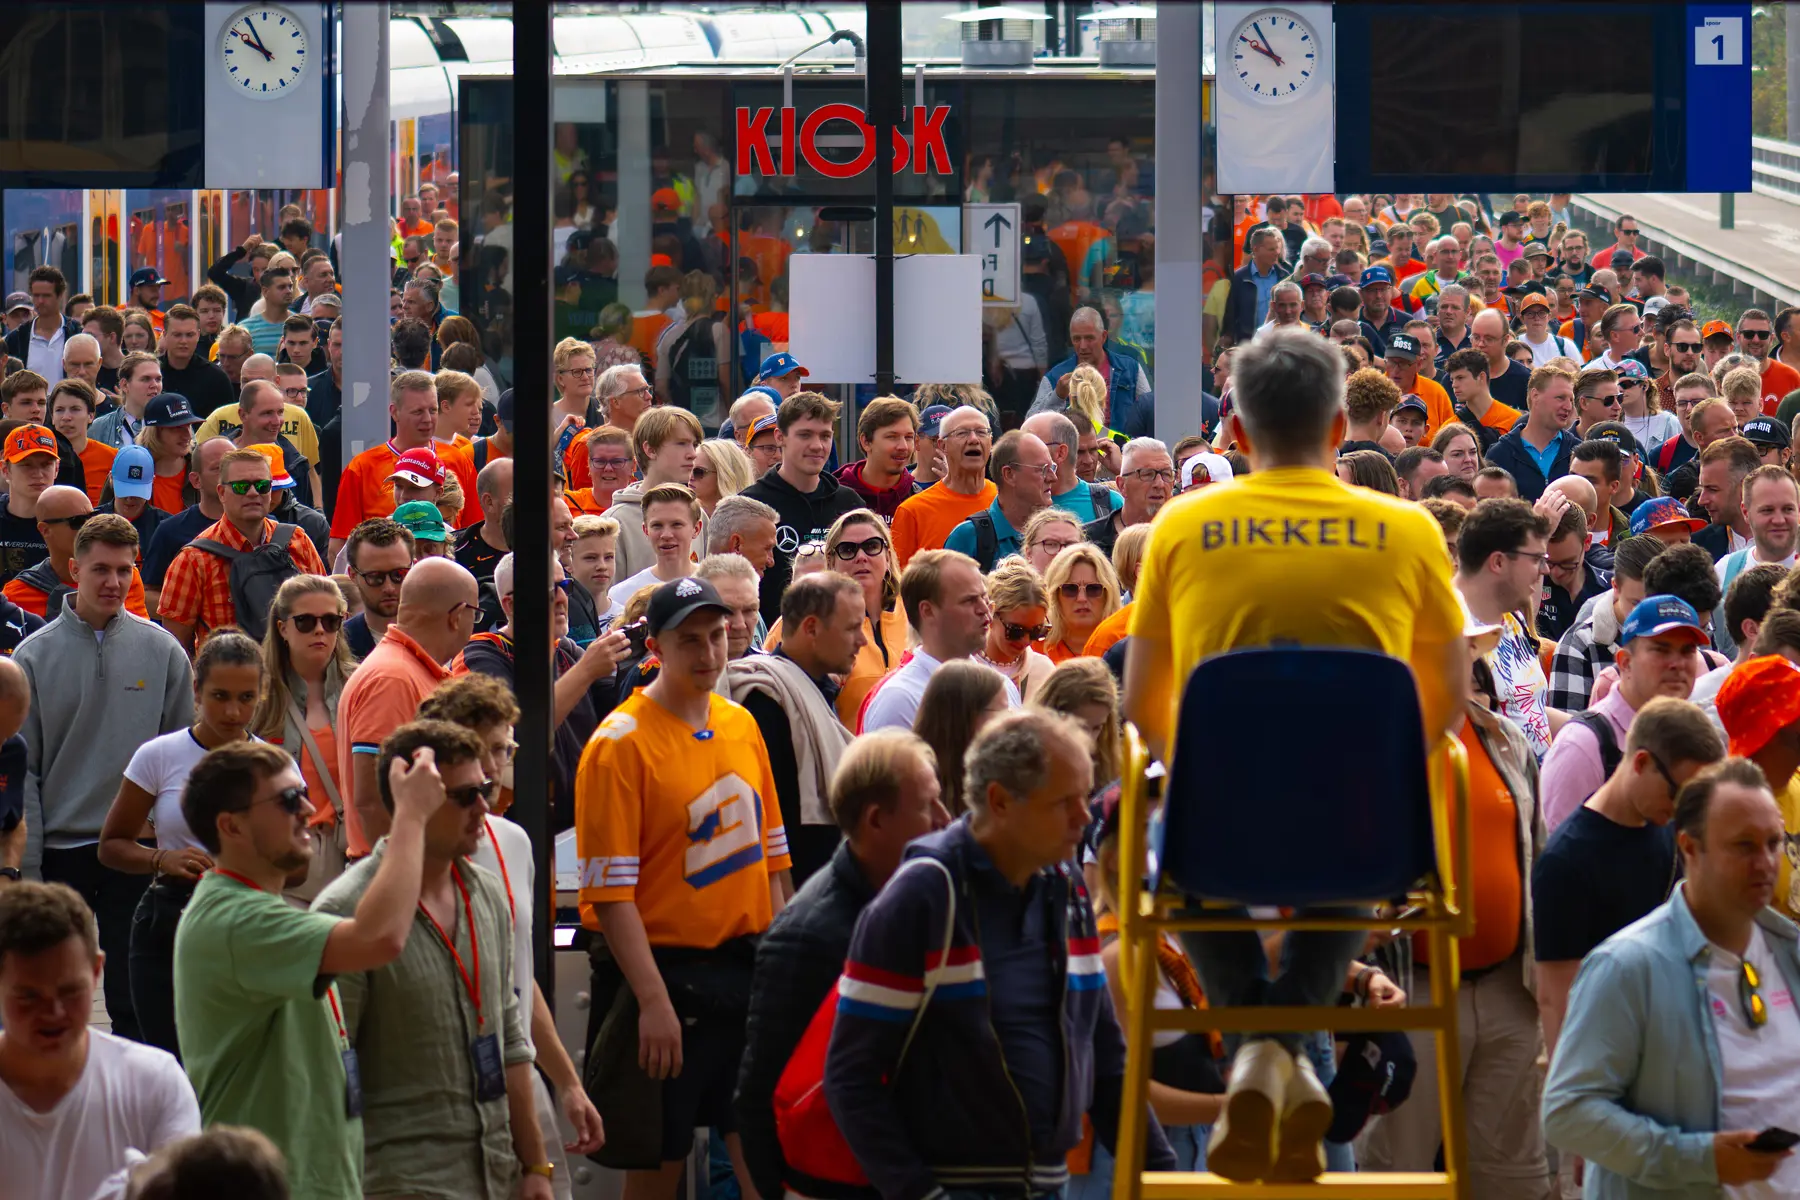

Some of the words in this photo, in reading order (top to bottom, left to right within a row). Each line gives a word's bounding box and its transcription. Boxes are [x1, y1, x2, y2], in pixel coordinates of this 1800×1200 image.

[1711, 34, 1724, 61] 1
[1393, 340, 1412, 351] BOSS
[401, 456, 431, 471] Santander
[1202, 516, 1387, 552] BIKKEL!
